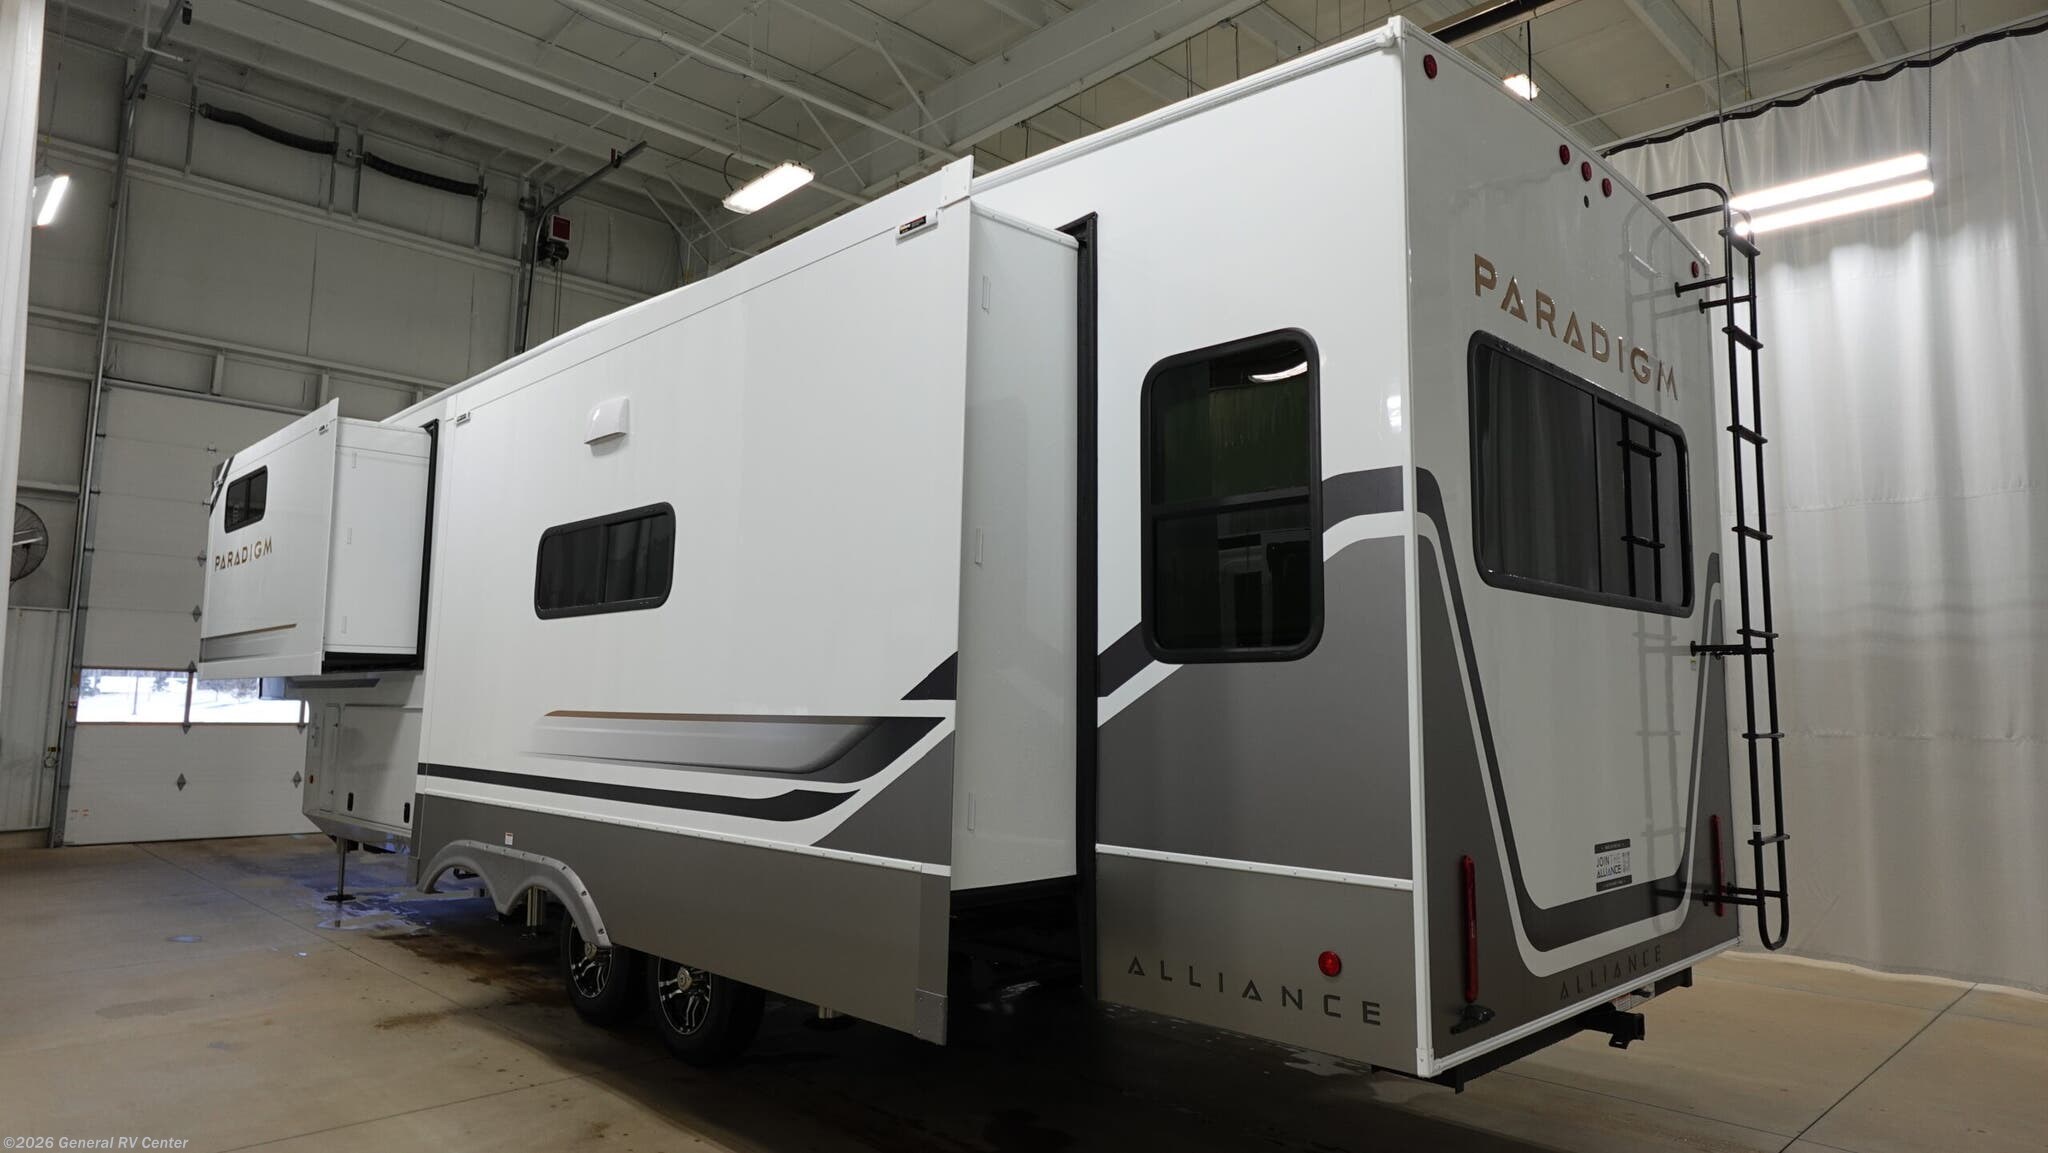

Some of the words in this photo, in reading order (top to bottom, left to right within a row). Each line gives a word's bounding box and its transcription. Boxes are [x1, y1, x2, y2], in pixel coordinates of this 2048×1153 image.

[1474, 253, 1678, 401] PARADIGM
[214, 536, 272, 572] PARADIGM
[1596, 864, 1621, 879] ALLIANCE
[1128, 956, 1381, 1026] ALLIANCE
[1561, 944, 1662, 1001] ALLIANCE
